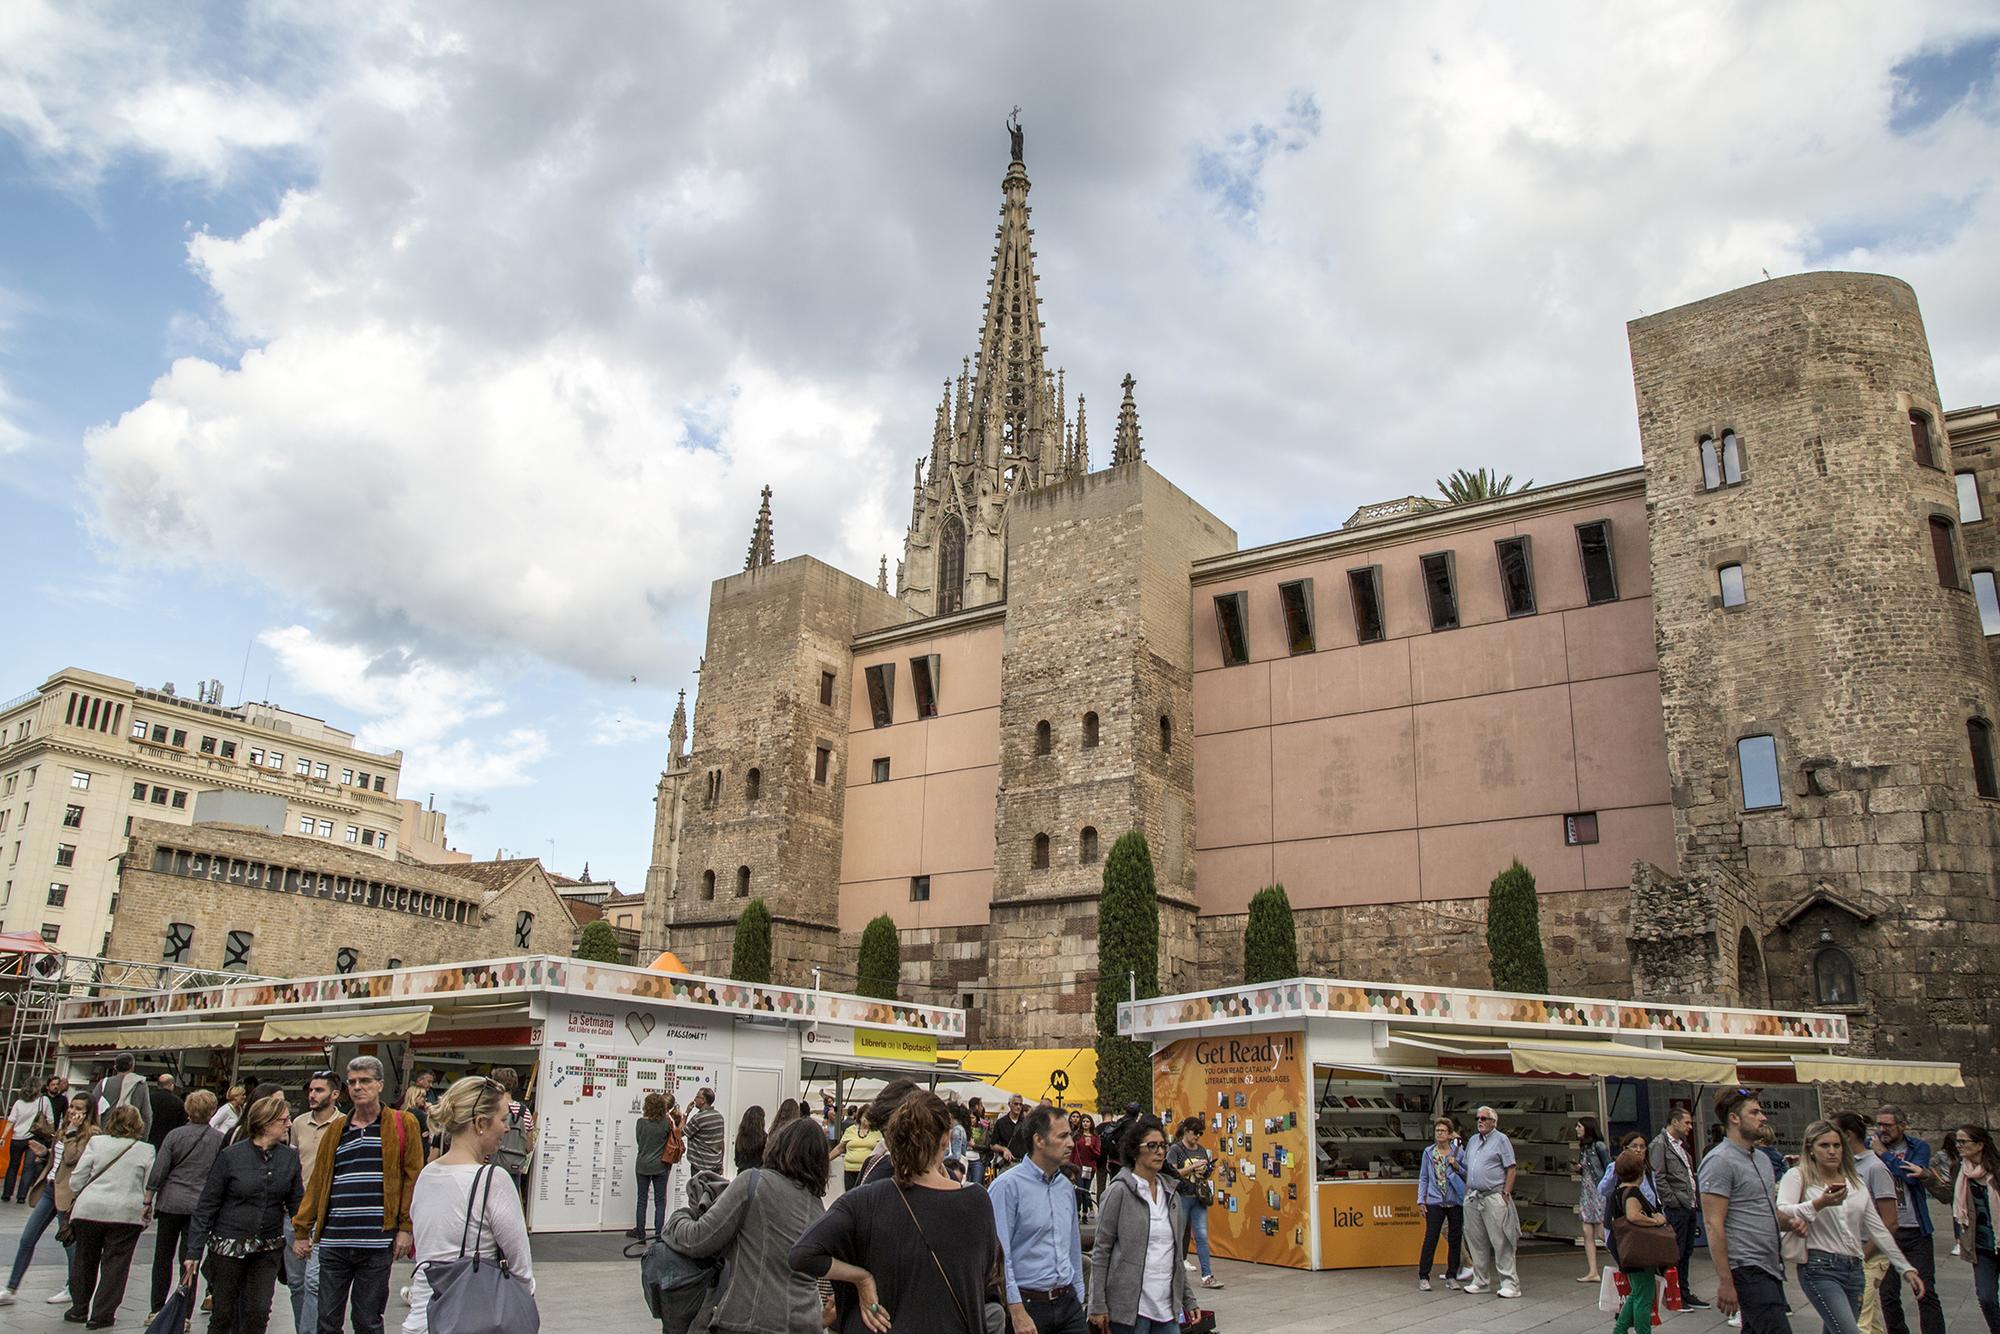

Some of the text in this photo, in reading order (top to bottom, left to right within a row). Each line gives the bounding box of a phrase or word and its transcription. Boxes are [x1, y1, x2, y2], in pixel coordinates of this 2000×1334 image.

[568, 1013, 578, 1025] La
[580, 1014, 614, 1029] Setmana
[532, 1029, 542, 1041] 37
[576, 1026, 590, 1034] Llibre
[861, 1037, 887, 1049] Llibreria
[887, 1040, 896, 1049] de
[902, 1042, 932, 1053] Diputació
[1195, 1036, 1294, 1070] Get Ready!!
[1204, 1067, 1216, 1075] YOU
[1053, 1072, 1067, 1087] M
[1204, 1076, 1235, 1085] LITERATURE
[1244, 1074, 1254, 1085] 62
[1333, 1206, 1364, 1228] laie
